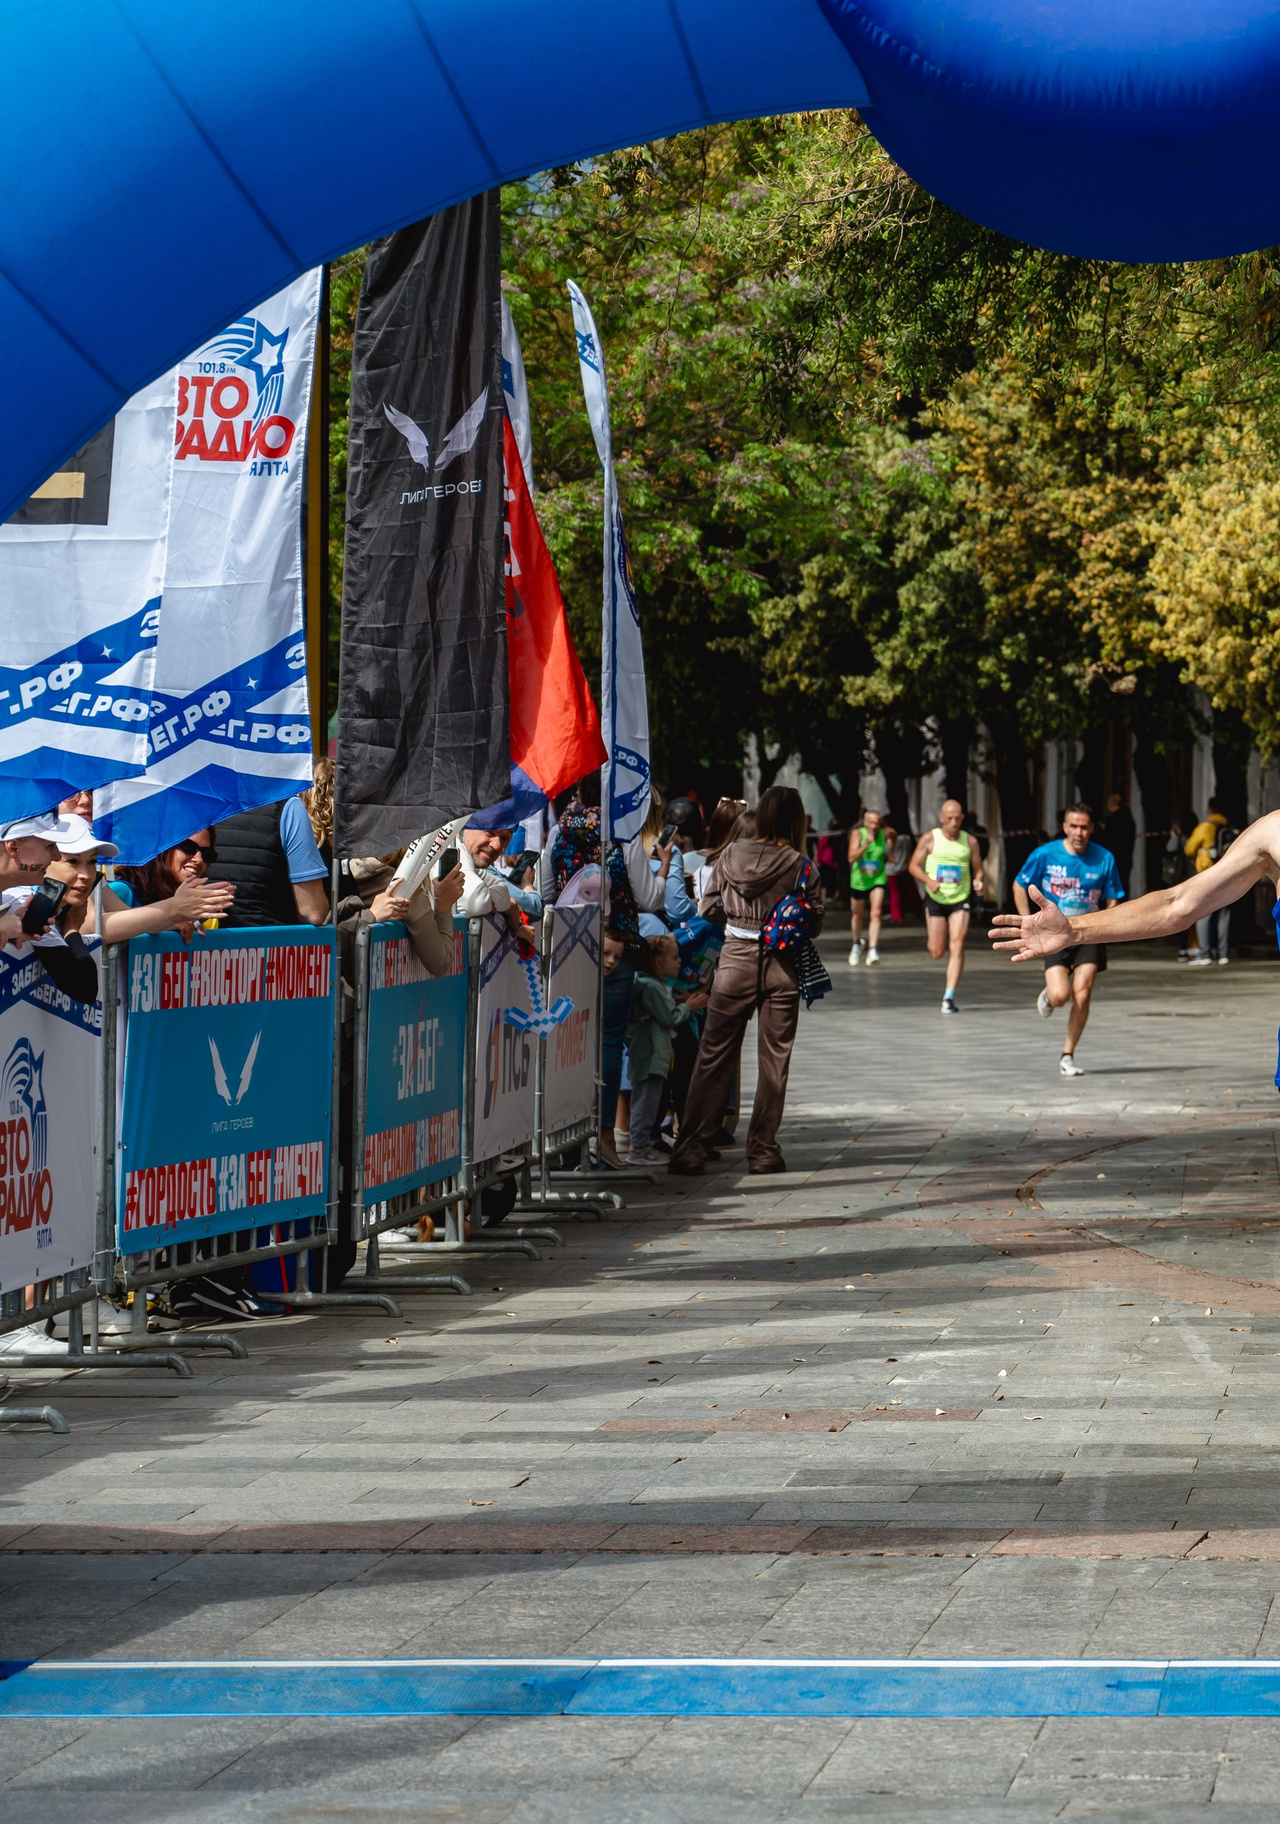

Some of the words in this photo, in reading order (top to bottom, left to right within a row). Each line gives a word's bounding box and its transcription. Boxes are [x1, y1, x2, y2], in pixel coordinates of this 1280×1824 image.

[198, 362, 226, 374] 101.8
[249, 461, 289, 477] ЯЛТА
[190, 948, 265, 1007] #ВОСТОРГ
[265, 944, 331, 1001] #МОМЕНТ
[212, 1121, 228, 1133] ЛИГА
[230, 1116, 254, 1132] ГЕРОЕВ
[124, 1158, 217, 1231] #ГОРДОСТЬ
[273, 1140, 325, 1201] #МЕЧТА
